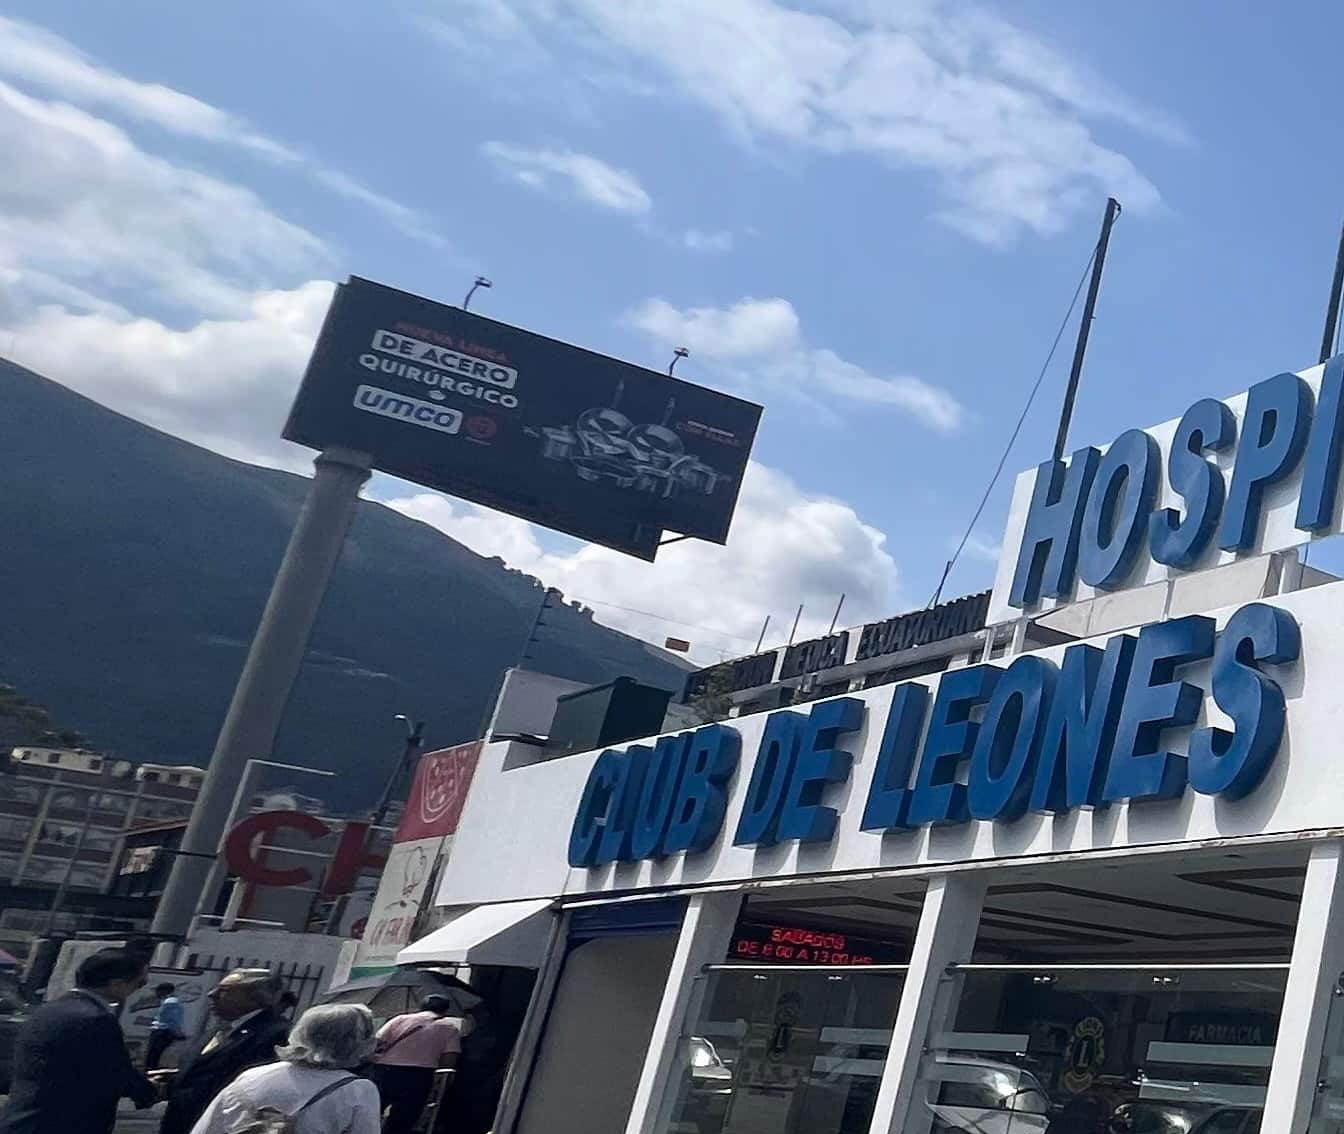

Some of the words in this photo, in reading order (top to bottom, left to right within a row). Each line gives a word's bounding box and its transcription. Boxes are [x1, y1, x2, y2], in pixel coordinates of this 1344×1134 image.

[359, 353, 518, 408] QUIRÚRGICO
[380, 334, 416, 355] DE
[420, 348, 511, 383] ACERO
[568, 722, 742, 868] CLUB
[734, 697, 865, 848] DE
[861, 604, 1303, 832] LEONES
[1187, 1024, 1263, 1042] FARMACIA
